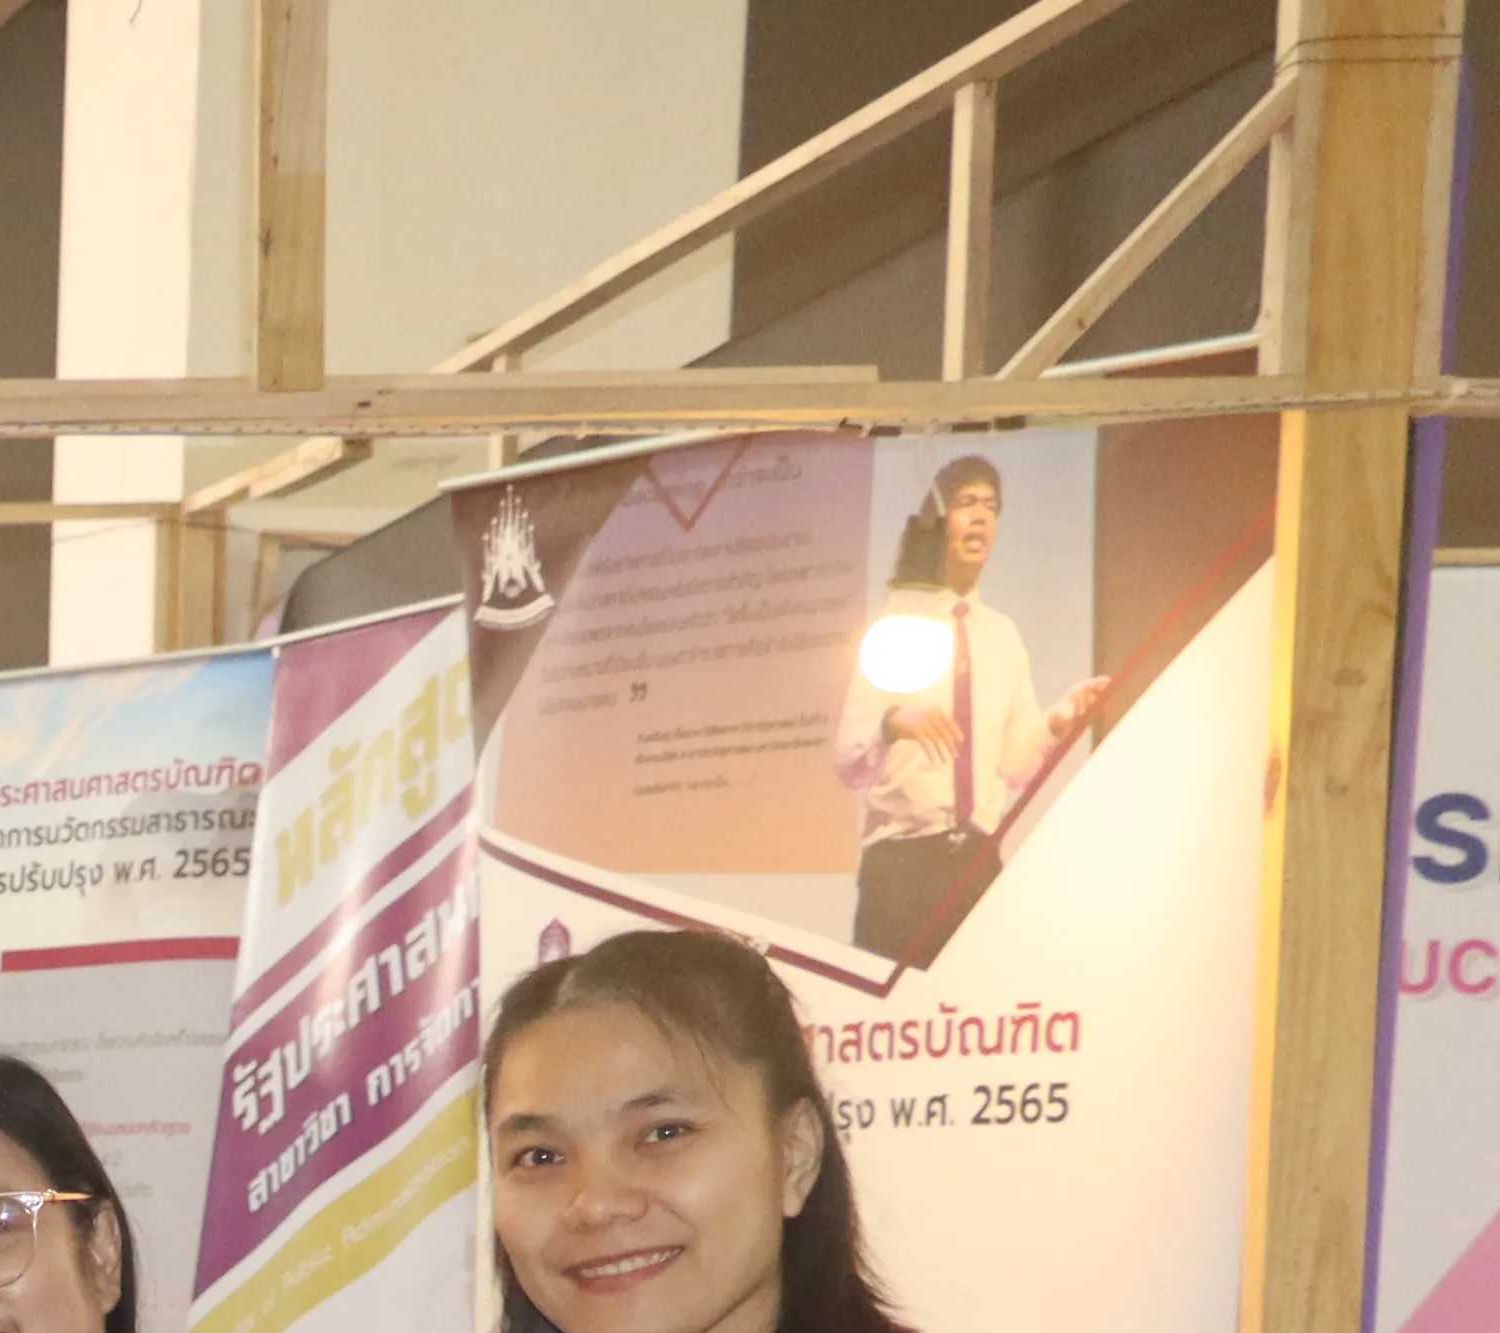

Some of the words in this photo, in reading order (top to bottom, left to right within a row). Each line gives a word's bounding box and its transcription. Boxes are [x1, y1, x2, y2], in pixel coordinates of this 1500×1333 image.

[114, 855, 162, 884] พ.ศ.
[172, 846, 251, 879] 2565
[890, 1093, 956, 1128] พ.ศ.
[971, 1082, 1069, 1125] 2565
[247, 1092, 354, 1213] สาขาวิชา
